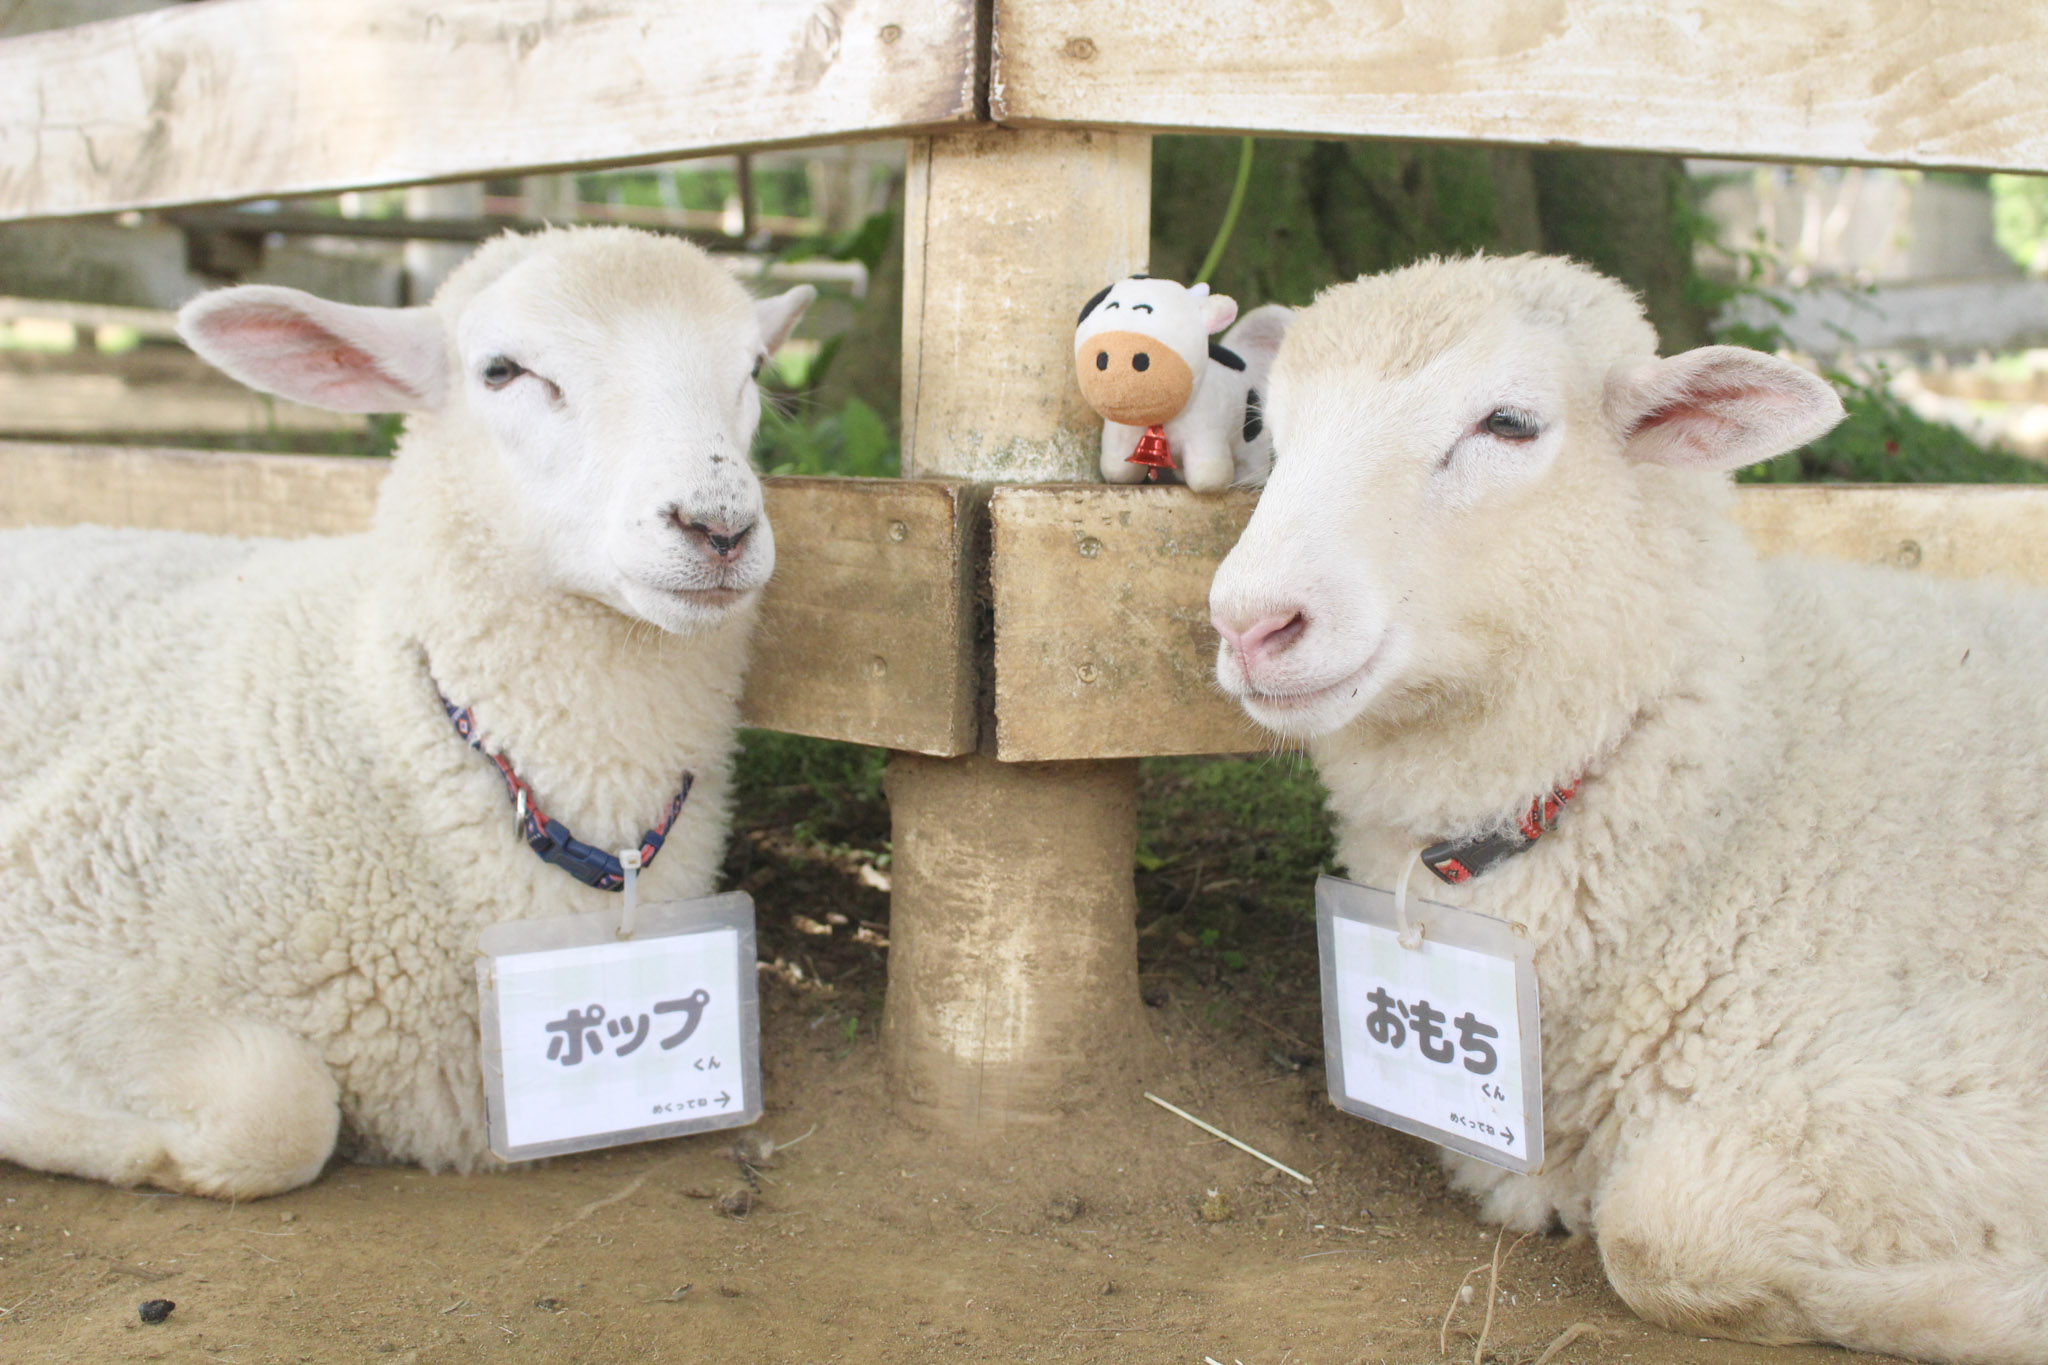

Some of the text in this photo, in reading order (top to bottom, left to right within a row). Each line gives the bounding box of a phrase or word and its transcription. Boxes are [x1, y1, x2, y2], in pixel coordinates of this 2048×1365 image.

[545, 988, 710, 1066] ポップ
[1366, 987, 1499, 1075] おもち
[693, 1056, 721, 1071] くん
[1481, 1083, 1505, 1101] くん
[1449, 1112, 1495, 1136] めくってね
